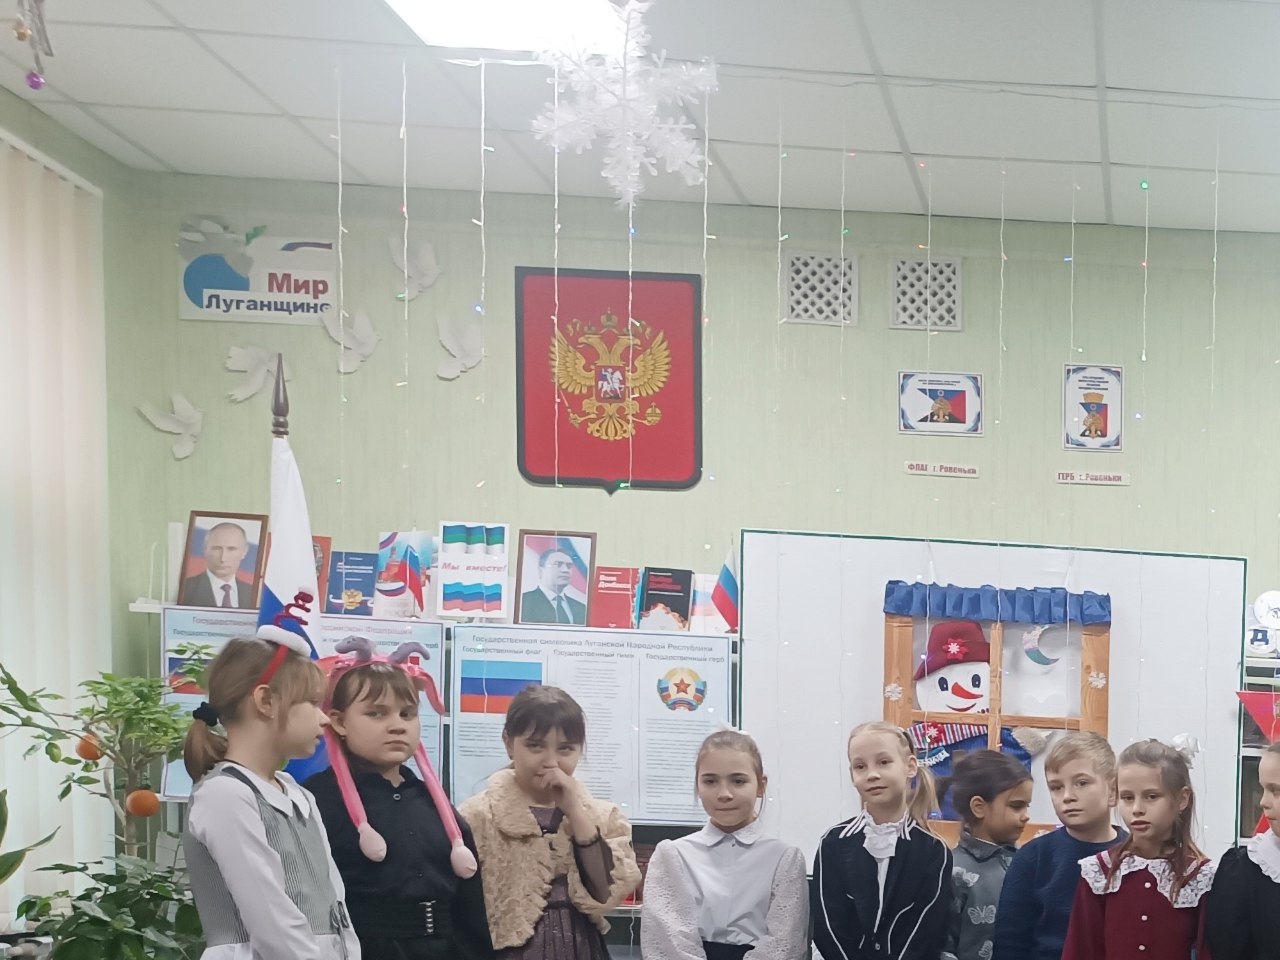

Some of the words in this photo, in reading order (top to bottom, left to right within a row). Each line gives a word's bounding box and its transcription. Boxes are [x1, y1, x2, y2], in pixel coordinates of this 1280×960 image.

[268, 272, 329, 299] Мир
[907, 462, 929, 472] ФЛАГ
[939, 464, 977, 475] Ровеньки
[1057, 472, 1075, 481] ГЕРБ
[441, 561, 460, 572] Мы
[466, 563, 507, 574] вместе!
